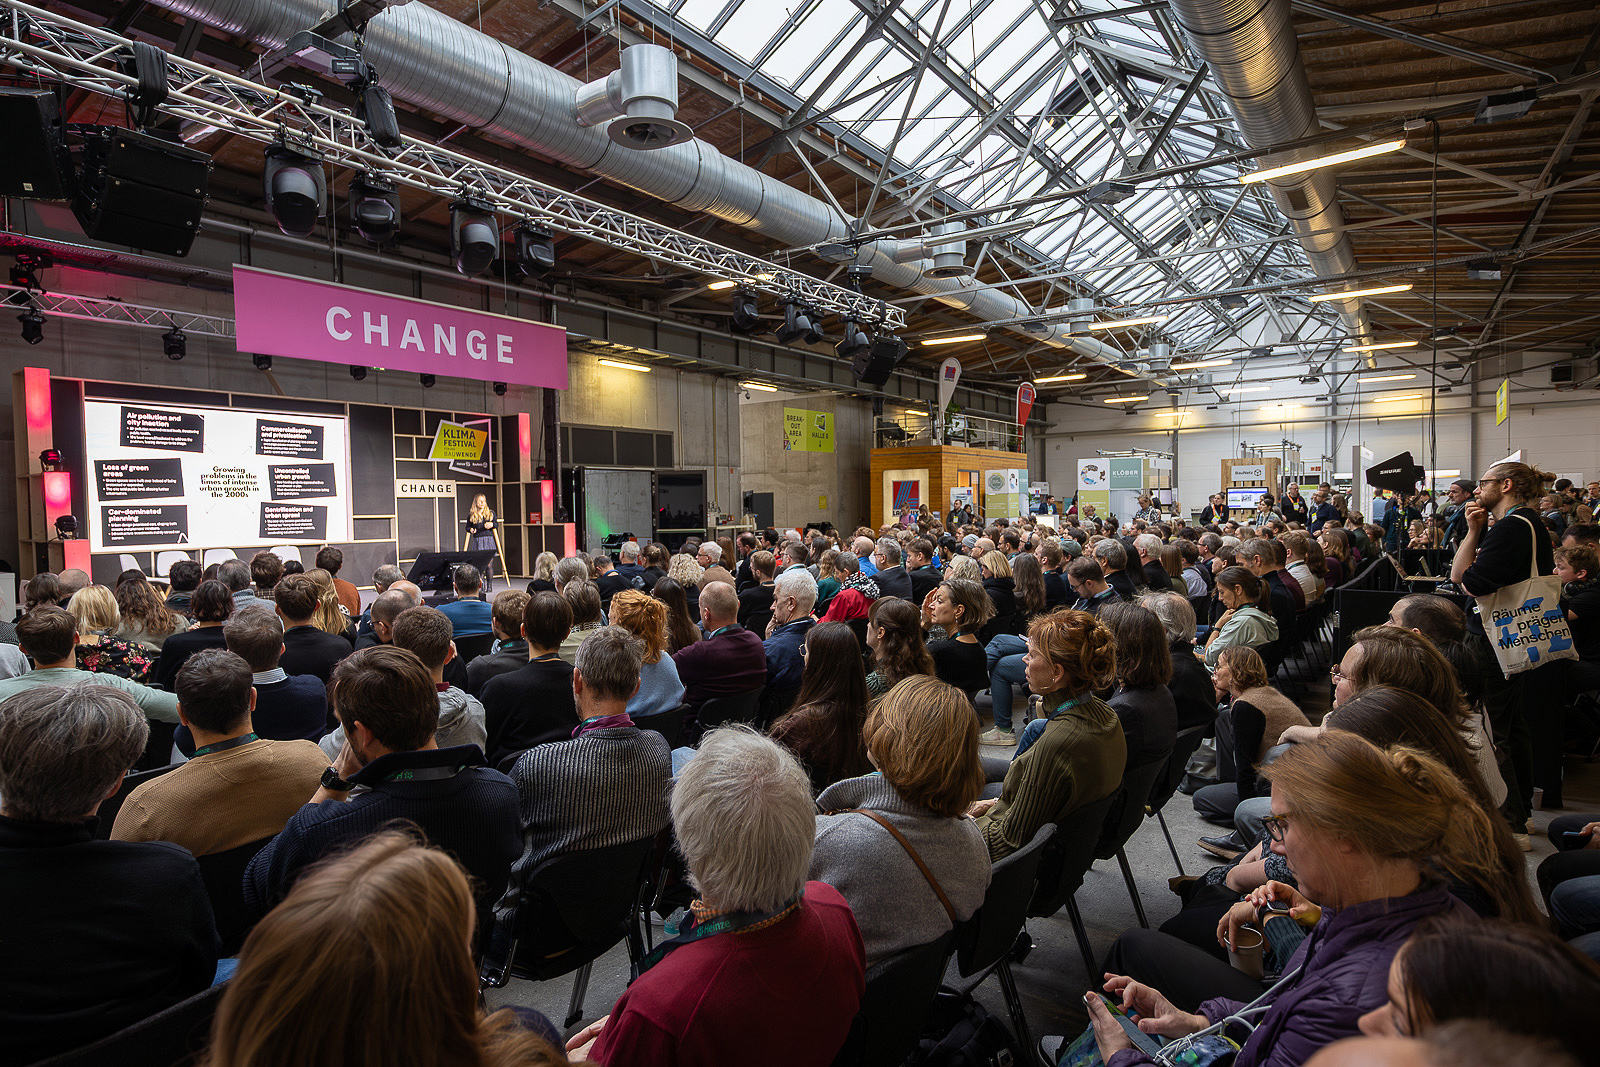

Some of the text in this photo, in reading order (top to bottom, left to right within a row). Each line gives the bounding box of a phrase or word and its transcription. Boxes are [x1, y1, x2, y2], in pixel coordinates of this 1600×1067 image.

[325, 306, 514, 364] CHANGE
[138, 413, 168, 421] pollution
[786, 414, 805, 423] BREAK-
[127, 419, 169, 428] city inaction
[790, 422, 801, 430] OUT
[443, 428, 476, 440] KLIMA
[812, 431, 825, 439] HALLE
[443, 440, 477, 448] FESTIVAL
[102, 463, 119, 471] Loss
[212, 466, 246, 474] Growing
[224, 485, 251, 493] growth
[401, 484, 452, 493] CHANGE
[108, 515, 139, 523] planning
[1492, 603, 1541, 622] Räume
[1498, 627, 1570, 650] Menschen
[703, 919, 731, 935] Heinze
